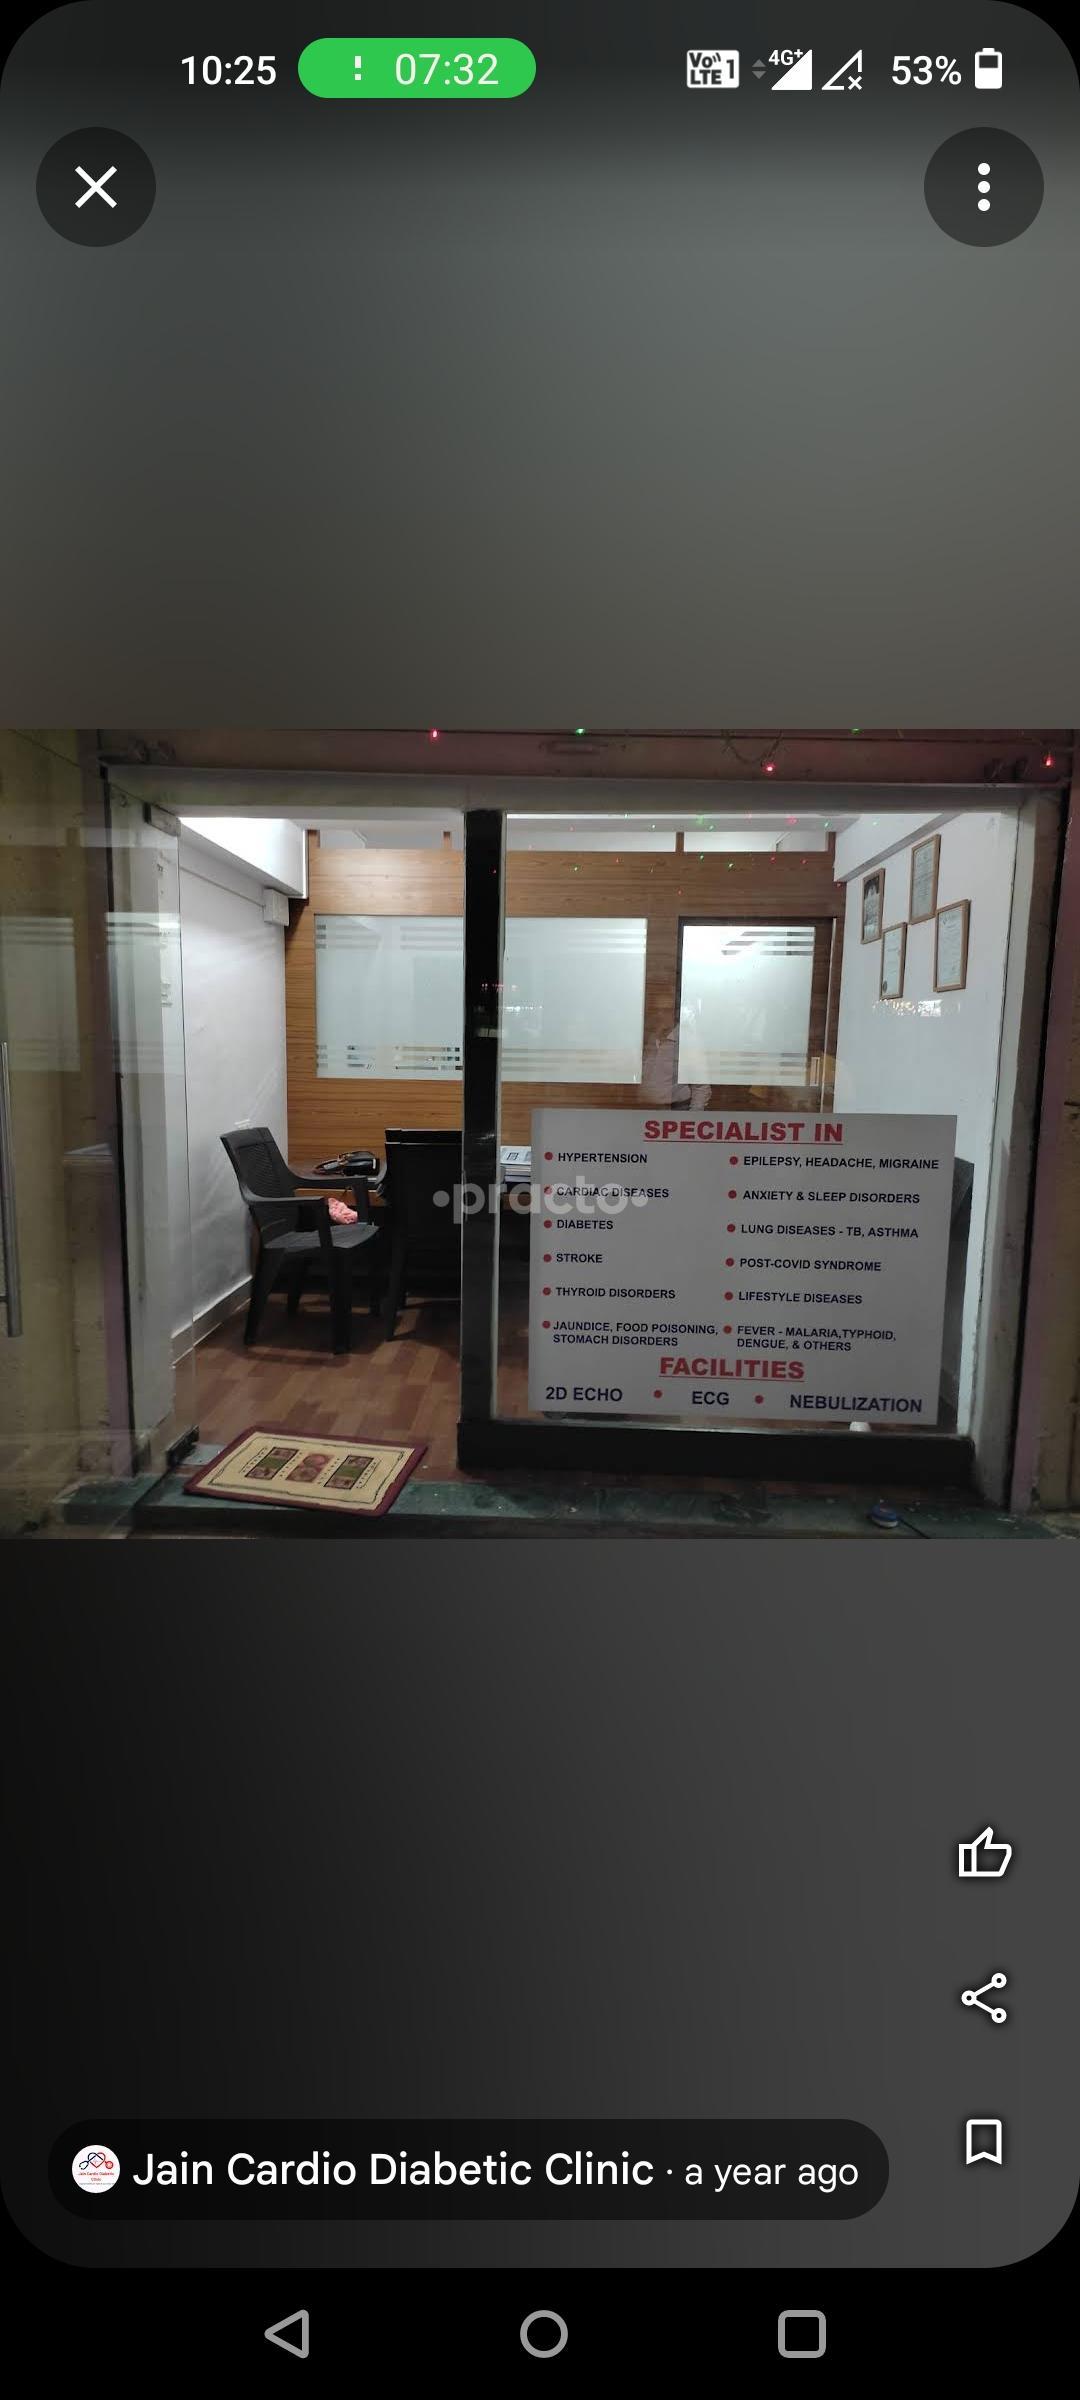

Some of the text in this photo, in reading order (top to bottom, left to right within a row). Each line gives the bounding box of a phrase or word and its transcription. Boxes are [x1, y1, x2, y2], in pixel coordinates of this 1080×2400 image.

[643, 1121, 843, 1142] SPECIALIST IN
[558, 1152, 648, 1164] HYPERTENSION
[743, 1155, 939, 1170] EPILEPSY, HEADACHE, MIGRAINE
[556, 1186, 670, 1198] CARDIAC DISEASES
[742, 1190, 920, 1204] ANXIETY & SLEEP DISORDERS
[556, 1219, 614, 1230] DIABETES
[741, 1224, 774, 1234] LUNG
[777, 1224, 834, 1236] DISEASES
[846, 1226, 865, 1238] TB,
[867, 1227, 919, 1238] ASTHMA
[556, 1253, 603, 1264] STROKE
[739, 1258, 881, 1272] POST-COVID SYNDROME
[555, 1287, 676, 1299] THYROID DISORDERS
[738, 1291, 863, 1305] LIFESTYLE DISEASES
[553, 1320, 718, 1335] JAUNDICE, FOOD POISONING,
[737, 1325, 776, 1336] FEVER
[553, 1333, 678, 1347] STOMACH DISORDERS
[737, 1338, 852, 1352] DENGUE, & OTHERS
[659, 1357, 805, 1379] FACILITIES
[545, 1386, 623, 1402] 2D ECHO
[692, 1390, 730, 1406] ECG
[790, 1394, 922, 1413] NEBULIZATION
